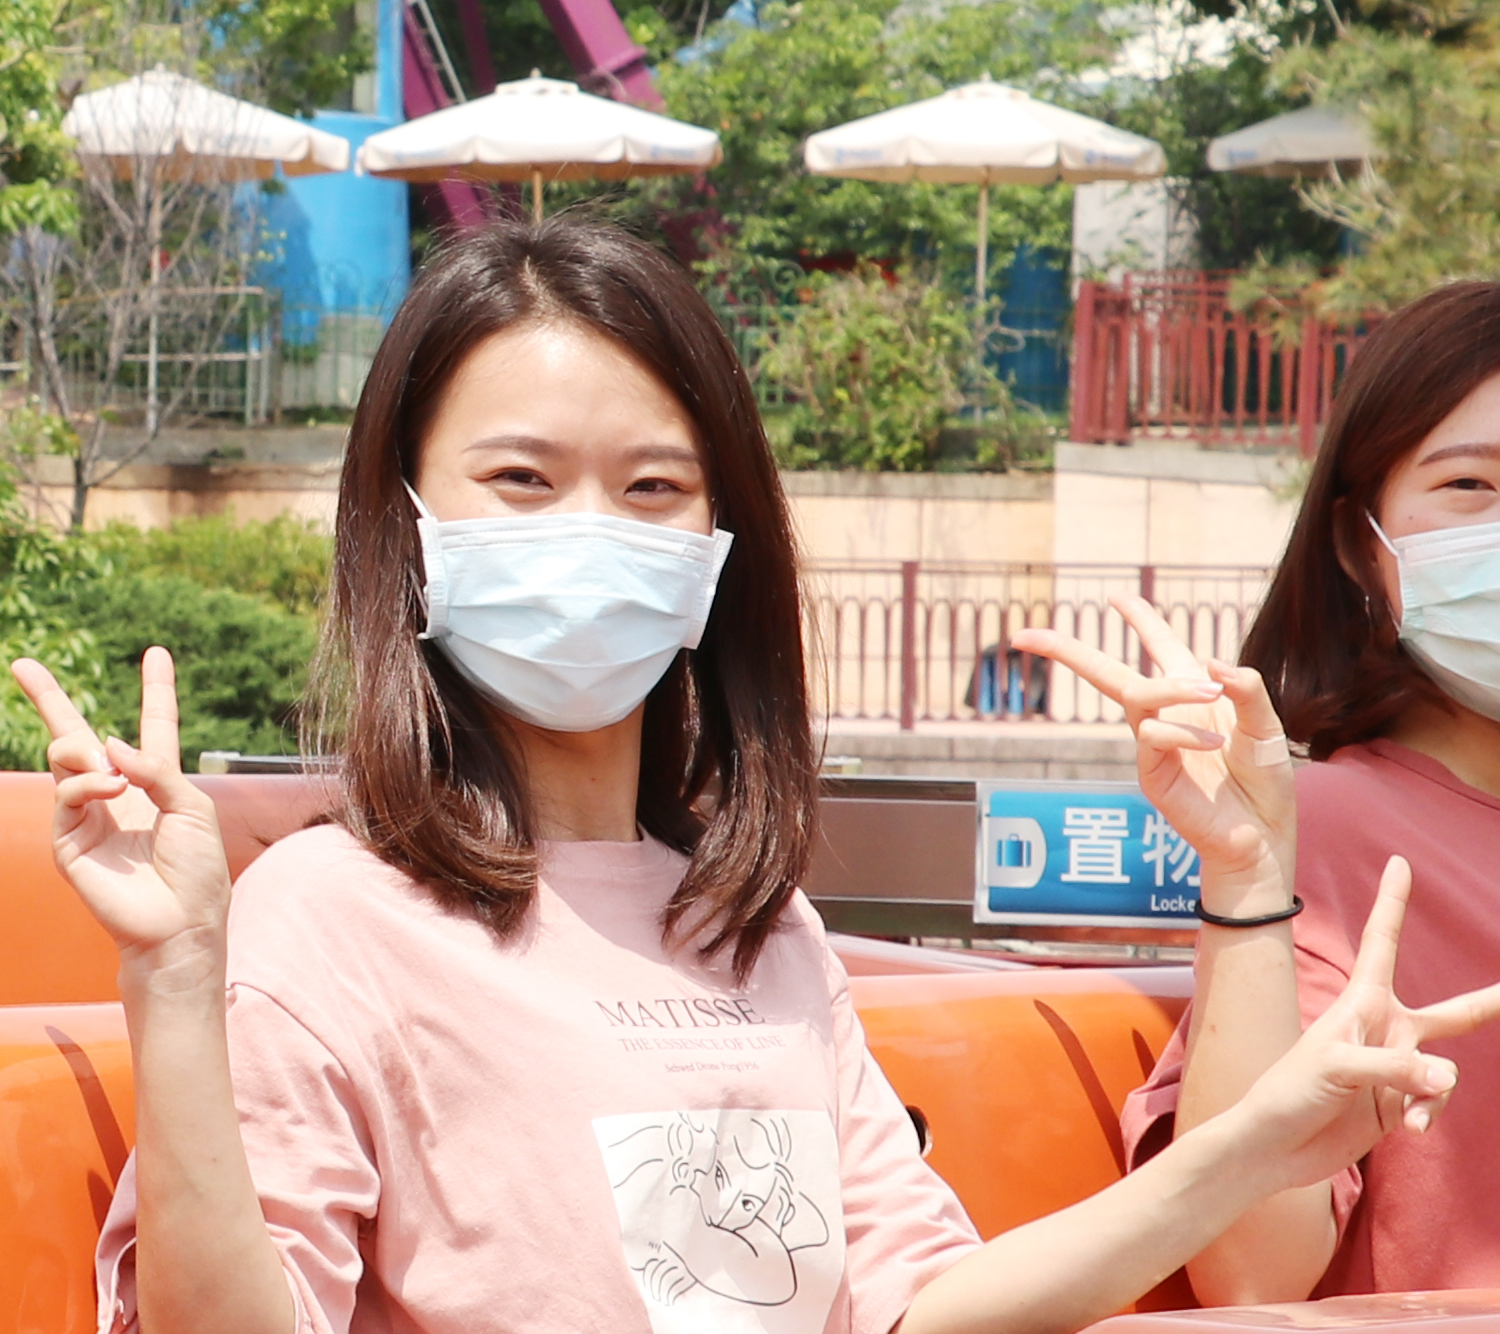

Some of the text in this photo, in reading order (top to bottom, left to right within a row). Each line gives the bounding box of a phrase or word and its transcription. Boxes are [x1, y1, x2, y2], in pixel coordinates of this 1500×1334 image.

[593, 998, 766, 1028] MATISSE
[617, 1035, 787, 1052] THE ESSENCE OF LINE
